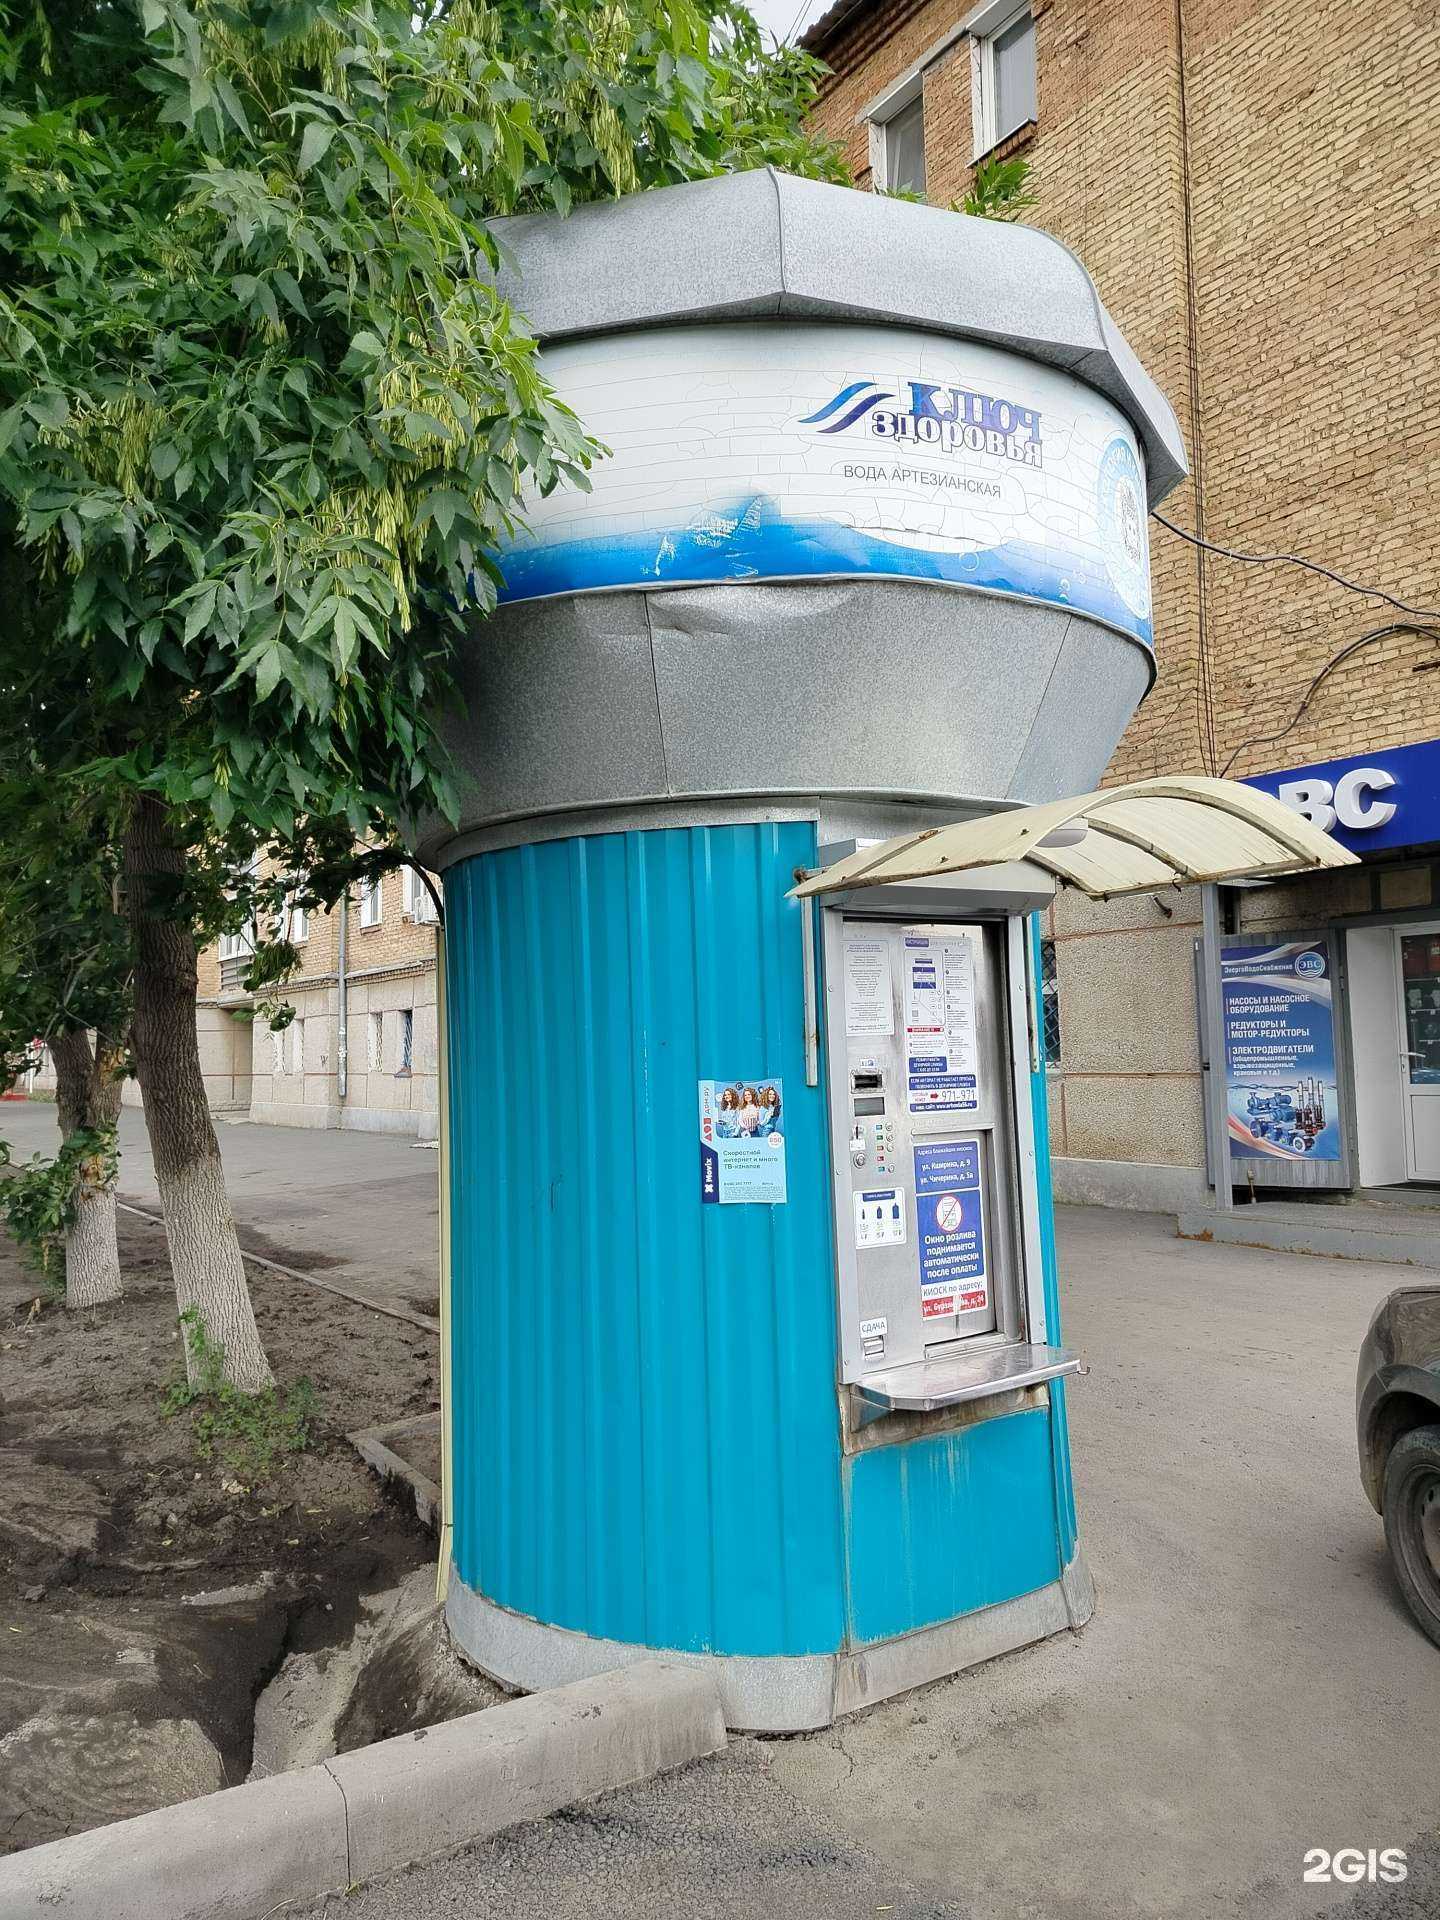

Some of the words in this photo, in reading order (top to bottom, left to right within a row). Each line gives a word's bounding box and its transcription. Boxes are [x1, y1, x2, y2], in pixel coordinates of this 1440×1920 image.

[844, 465, 887, 481] ВОДА
[891, 469, 1001, 498] АРТЕЗИАНСКАЯ
[1299, 960, 1320, 969] ЭВС
[1229, 997, 1261, 1006] НАСОСЫ
[1262, 996, 1269, 1004] И
[1270, 994, 1310, 1004] НАСОСНОЕ
[1230, 1004, 1289, 1014] ОБОРУДОВАНИЕ
[1231, 1020, 1278, 1030] РЕДУКТОРЫ
[1280, 1020, 1286, 1028] И
[1231, 1028, 1310, 1039] МОТОР-РЕДУКТОРЫ
[1232, 1044, 1314, 1055] ЭЛЕКТРОДВИГАТЕЛИ
[941, 1089, 975, 1102] 971-971
[924, 1235, 945, 1244] Окно
[946, 1231, 976, 1243] розлива
[926, 1242, 976, 1256] поднимается
[923, 1252, 979, 1267] автоматически
[927, 1268, 949, 1279] после
[950, 1264, 977, 1275] оплаты
[923, 1285, 947, 1297] КИОСК
[958, 1281, 983, 1291] адресу:
[862, 1321, 885, 1333] СДАЧА
